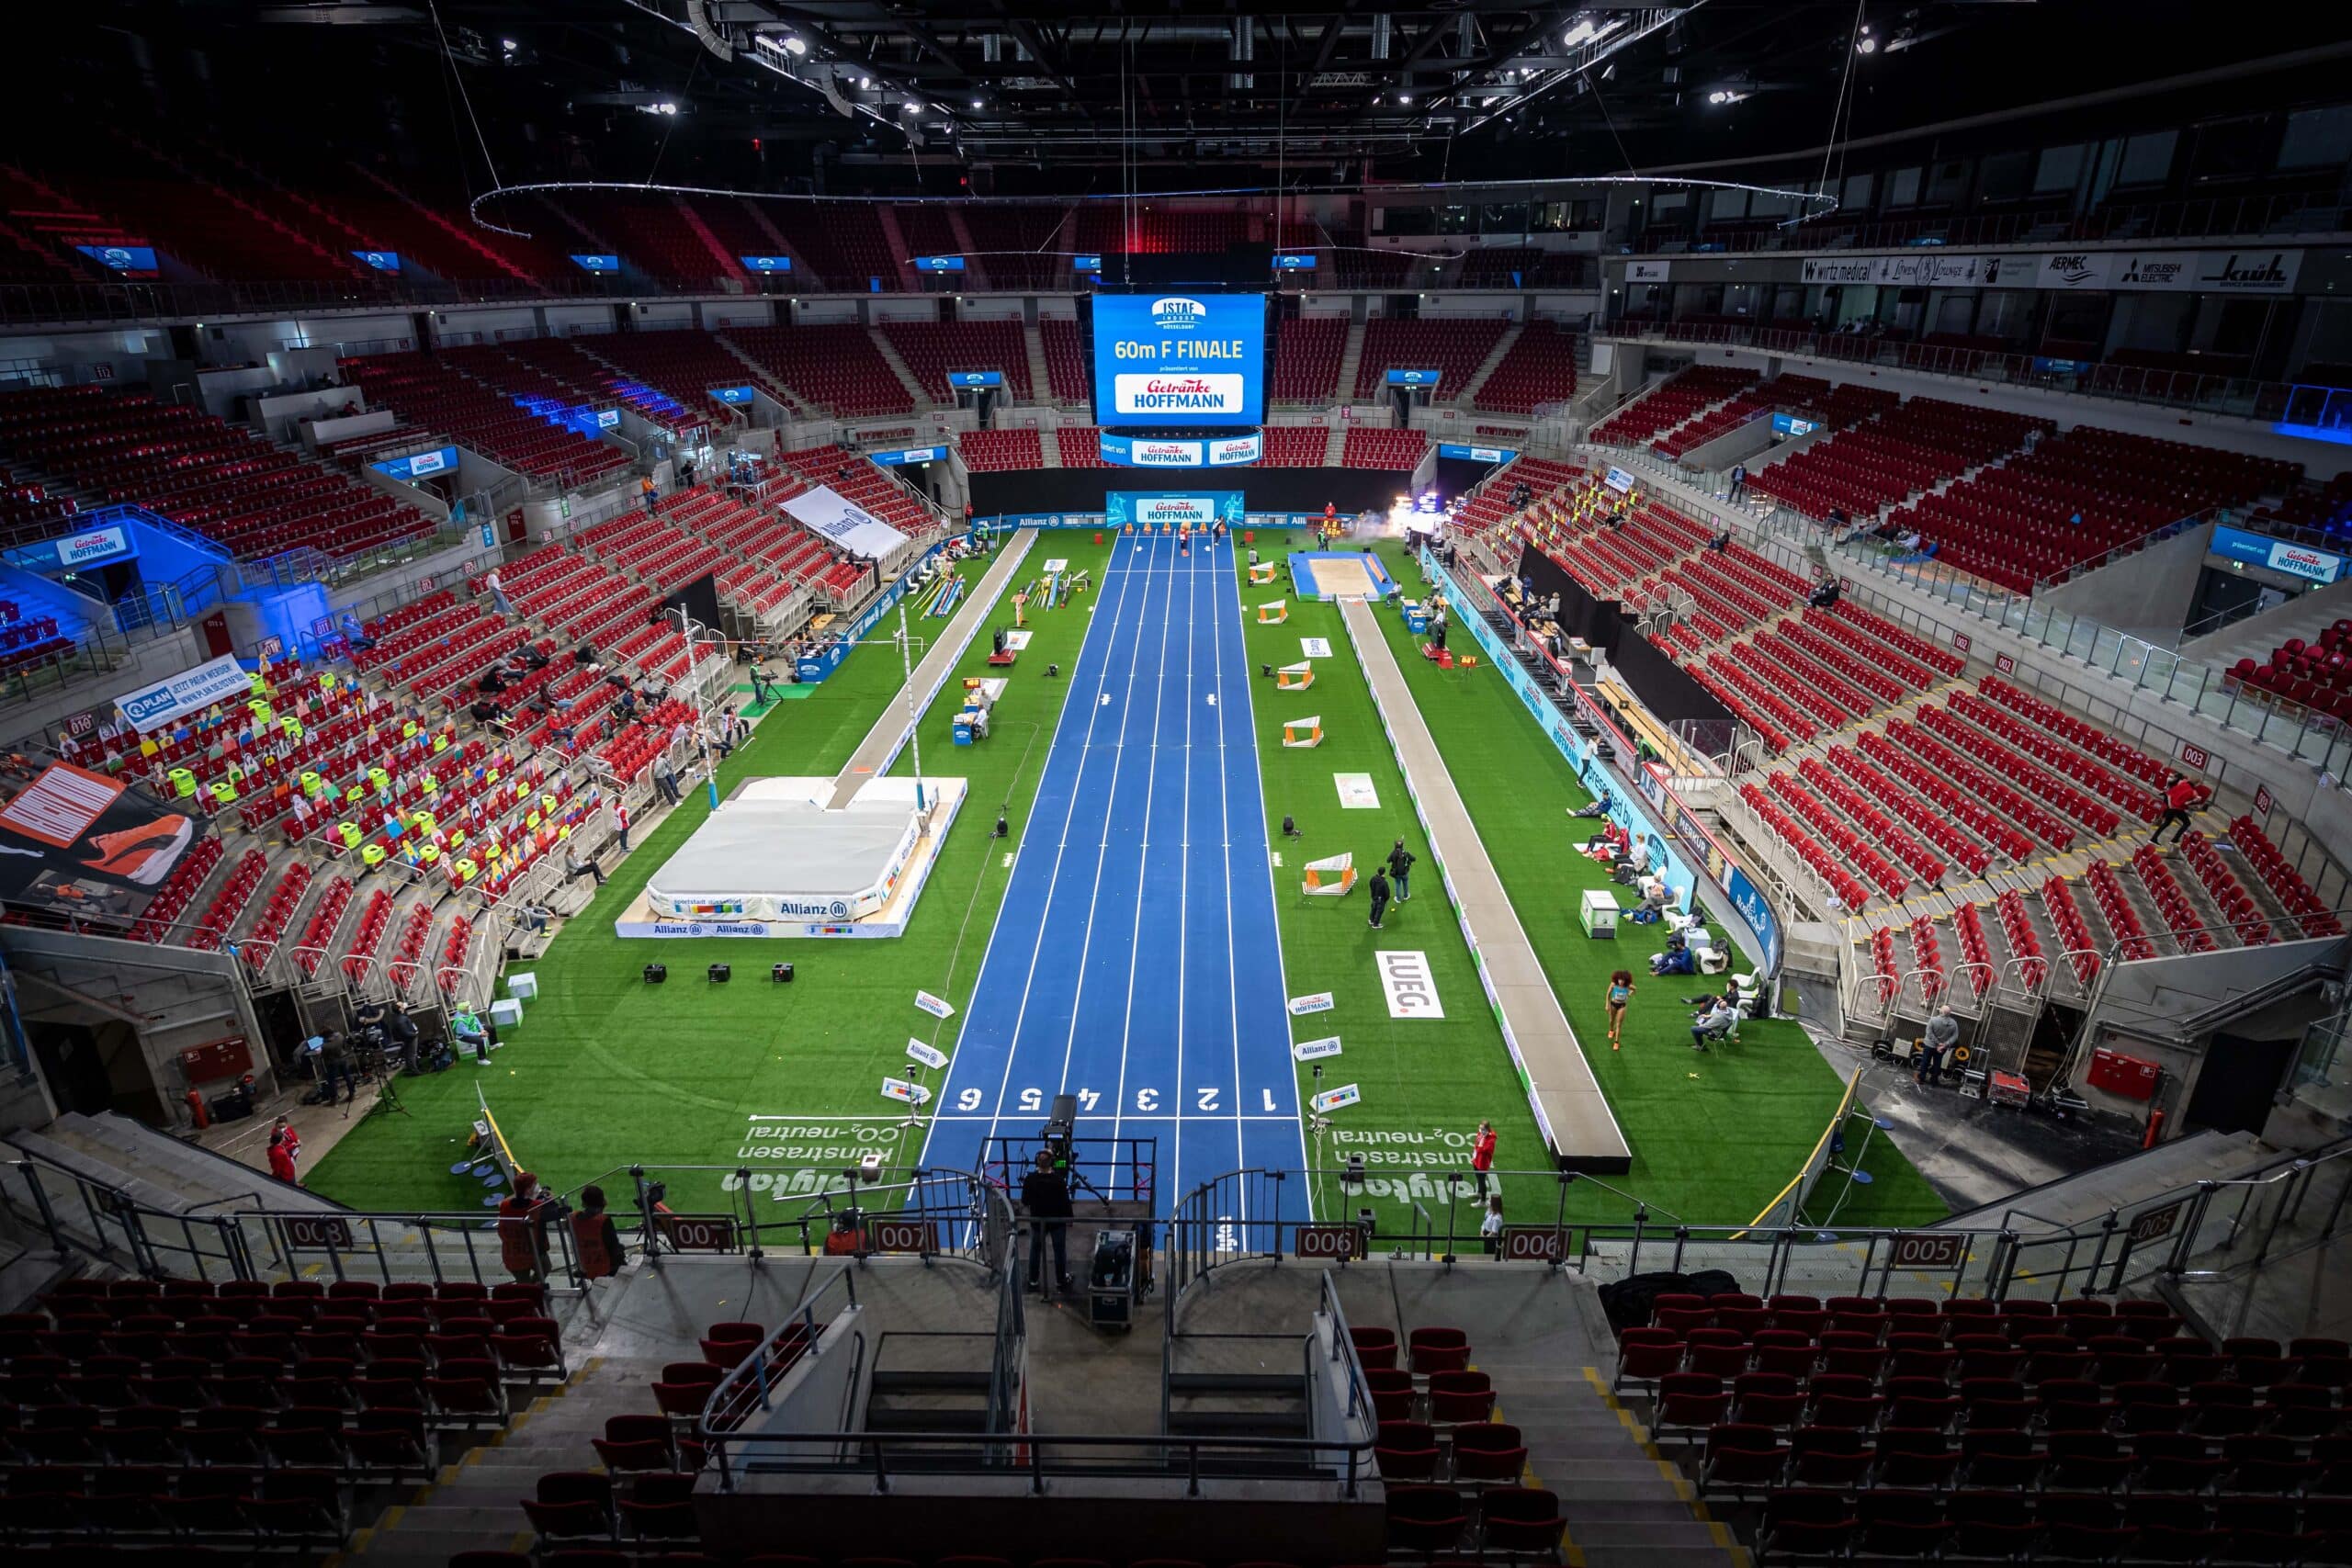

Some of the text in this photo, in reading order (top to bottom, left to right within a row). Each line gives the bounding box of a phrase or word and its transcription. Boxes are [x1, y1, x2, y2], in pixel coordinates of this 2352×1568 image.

[2049, 255, 2087, 271] AERMEC
[2143, 264, 2182, 273] MITSUBISHI
[1163, 302, 1194, 315] ISTAF
[1114, 340, 1243, 359] 60m F FINALE
[1148, 379, 1211, 393] Getränke
[1134, 394, 1224, 408] HOFFMANN
[1141, 453, 1192, 462] HOFFMANN
[1148, 445, 1183, 454] Getränke
[1219, 448, 1256, 461] HOFFMANN
[1148, 511, 1203, 520] HOFFMANN
[1155, 502, 1195, 511] Getränke
[820, 517, 860, 538] Allianz
[1019, 518, 1047, 526] Allianz
[70, 540, 118, 559] HOFFMANN
[2277, 556, 2327, 577] HOFFMANN
[1956, 636, 1968, 649] 002
[1998, 658, 2012, 673] 002
[142, 691, 173, 709] PLAN
[1521, 684, 1544, 723] HOFFMANN
[1553, 726, 1579, 770] HOFFMANN
[2185, 748, 2204, 766] 003
[1623, 807, 1634, 831] by
[1679, 816, 1707, 854] MERKUR
[781, 902, 828, 916] Allianz
[654, 925, 688, 934] Allianz
[717, 925, 750, 934] Allianz
[917, 998, 944, 1016] HOFFMANN
[1295, 1000, 1330, 1013] HOFFMANN
[910, 1043, 930, 1059] Allianz
[1302, 1044, 1327, 1055] Allianz
[957, 1088, 982, 1111] 6
[1018, 1088, 1042, 1111] 5
[1078, 1088, 1101, 1111] 4
[1136, 1088, 1159, 1111] 3
[1197, 1088, 1220, 1111] 2
[1262, 1088, 1277, 1111] 1
[2138, 1213, 2170, 1238] 005
[882, 1226, 923, 1247] 007
[1305, 1232, 1351, 1253] 006
[1513, 1234, 1560, 1256] 006
[1903, 1239, 1951, 1261] 005
